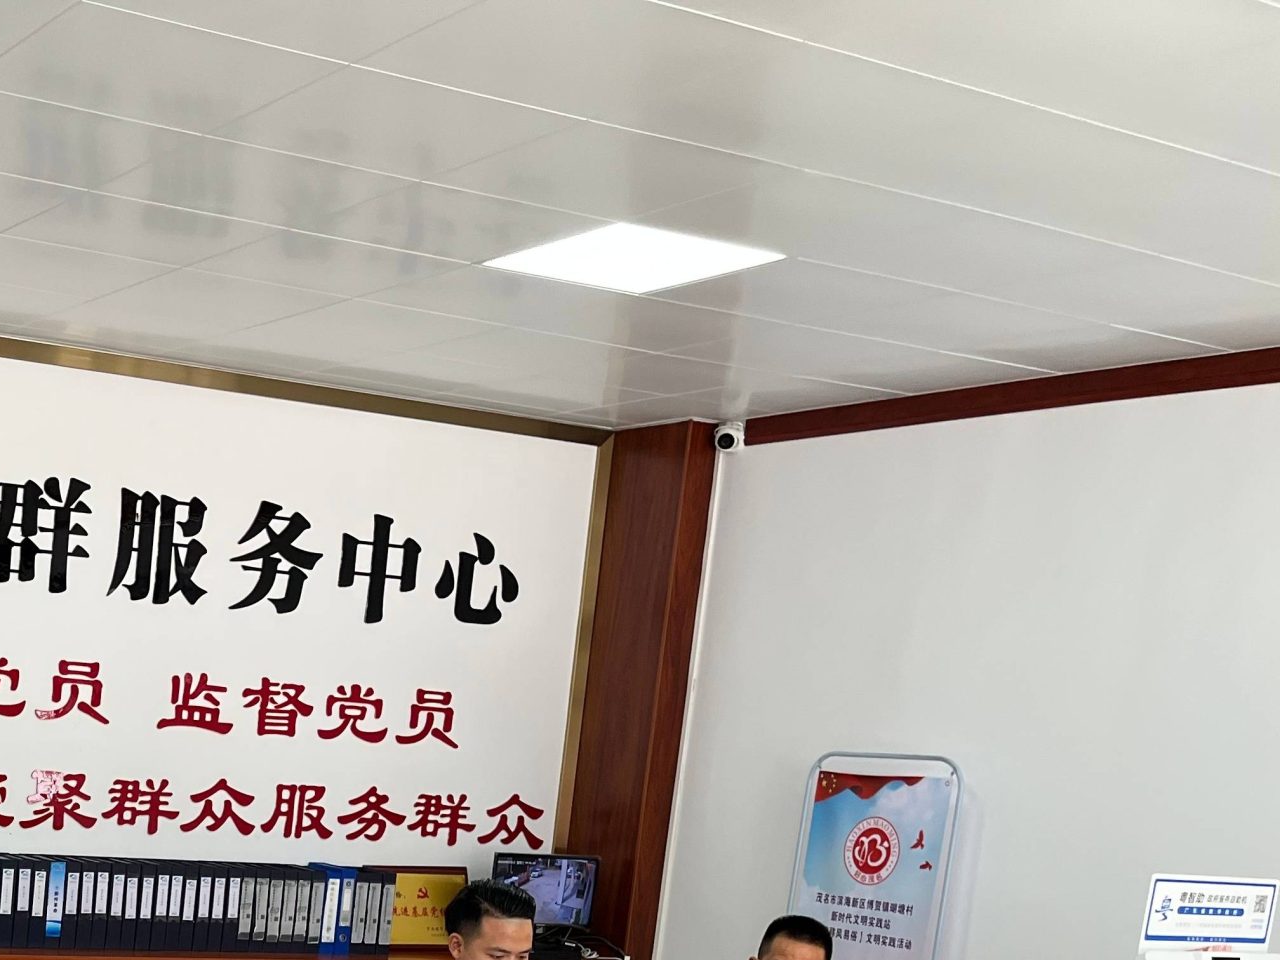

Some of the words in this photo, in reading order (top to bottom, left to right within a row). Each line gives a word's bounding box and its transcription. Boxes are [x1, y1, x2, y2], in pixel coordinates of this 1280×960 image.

[156, 672, 461, 748] 监督党员
[831, 911, 891, 930] 新时代文明实践站
